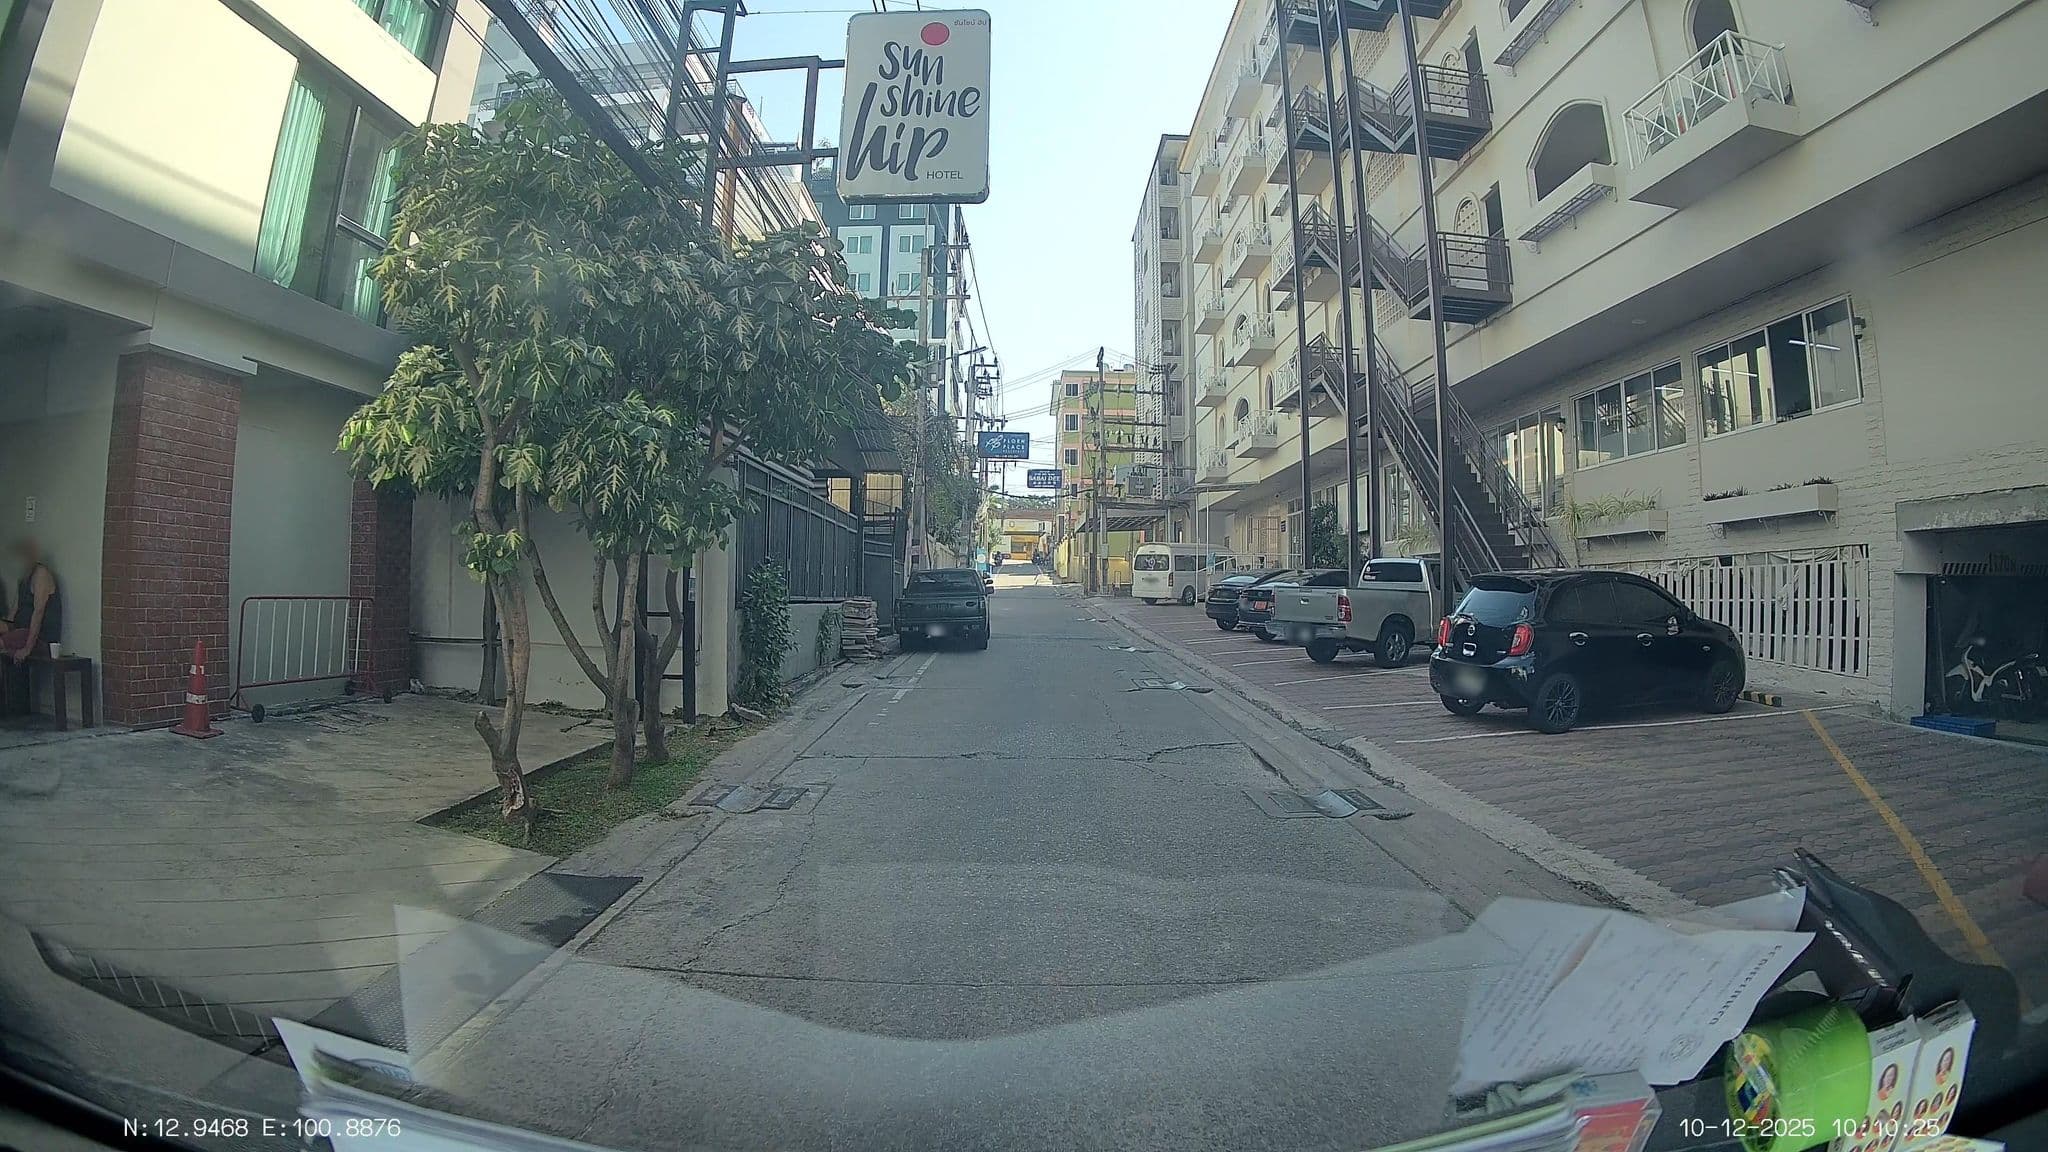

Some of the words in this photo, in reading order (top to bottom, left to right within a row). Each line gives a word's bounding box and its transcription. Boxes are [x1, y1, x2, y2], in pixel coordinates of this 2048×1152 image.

[878, 41, 944, 86] sun
[880, 73, 981, 118] shine
[845, 82, 949, 181] hip
[926, 170, 964, 180] HOTEL
